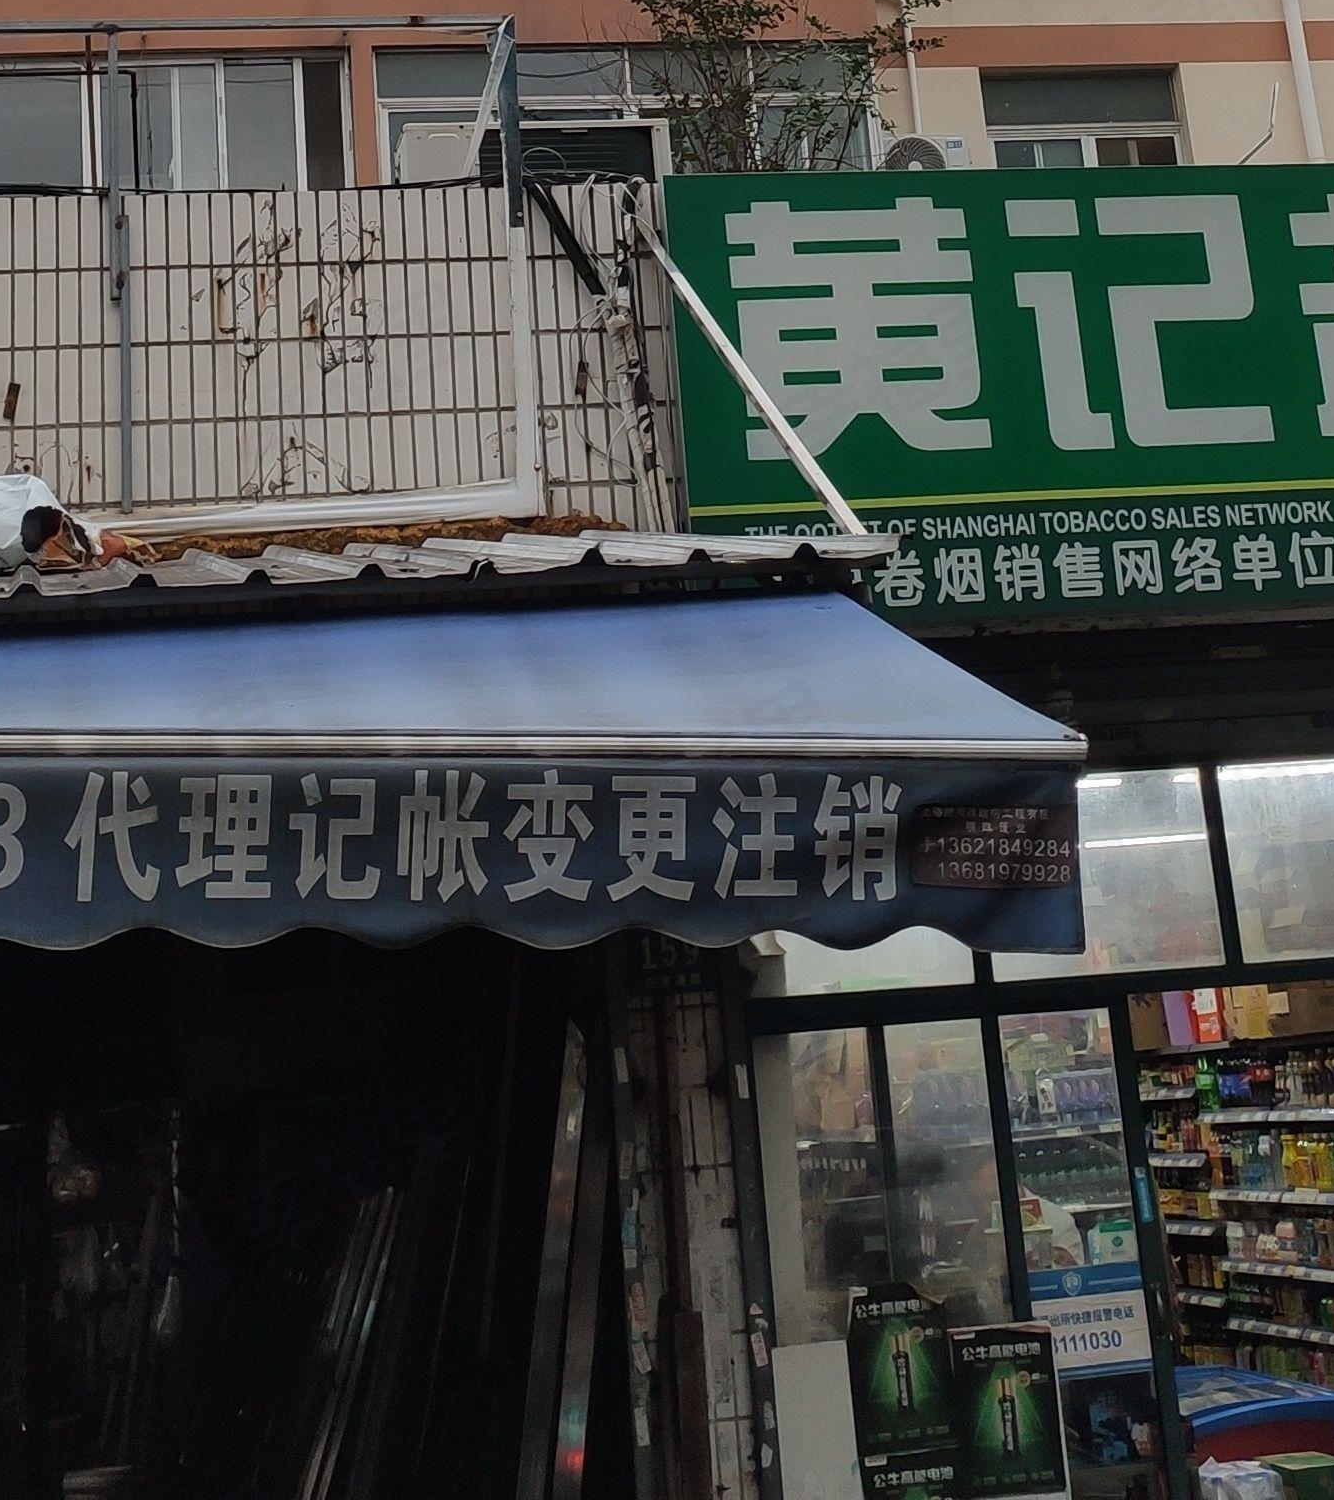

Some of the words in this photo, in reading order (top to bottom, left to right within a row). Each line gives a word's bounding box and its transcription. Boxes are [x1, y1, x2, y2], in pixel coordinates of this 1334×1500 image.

[922, 513, 1037, 541] SHANGHAI
[1039, 508, 1147, 536] TOBACCO
[1151, 504, 1222, 530] SALES
[1225, 500, 1334, 527] NETWORK
